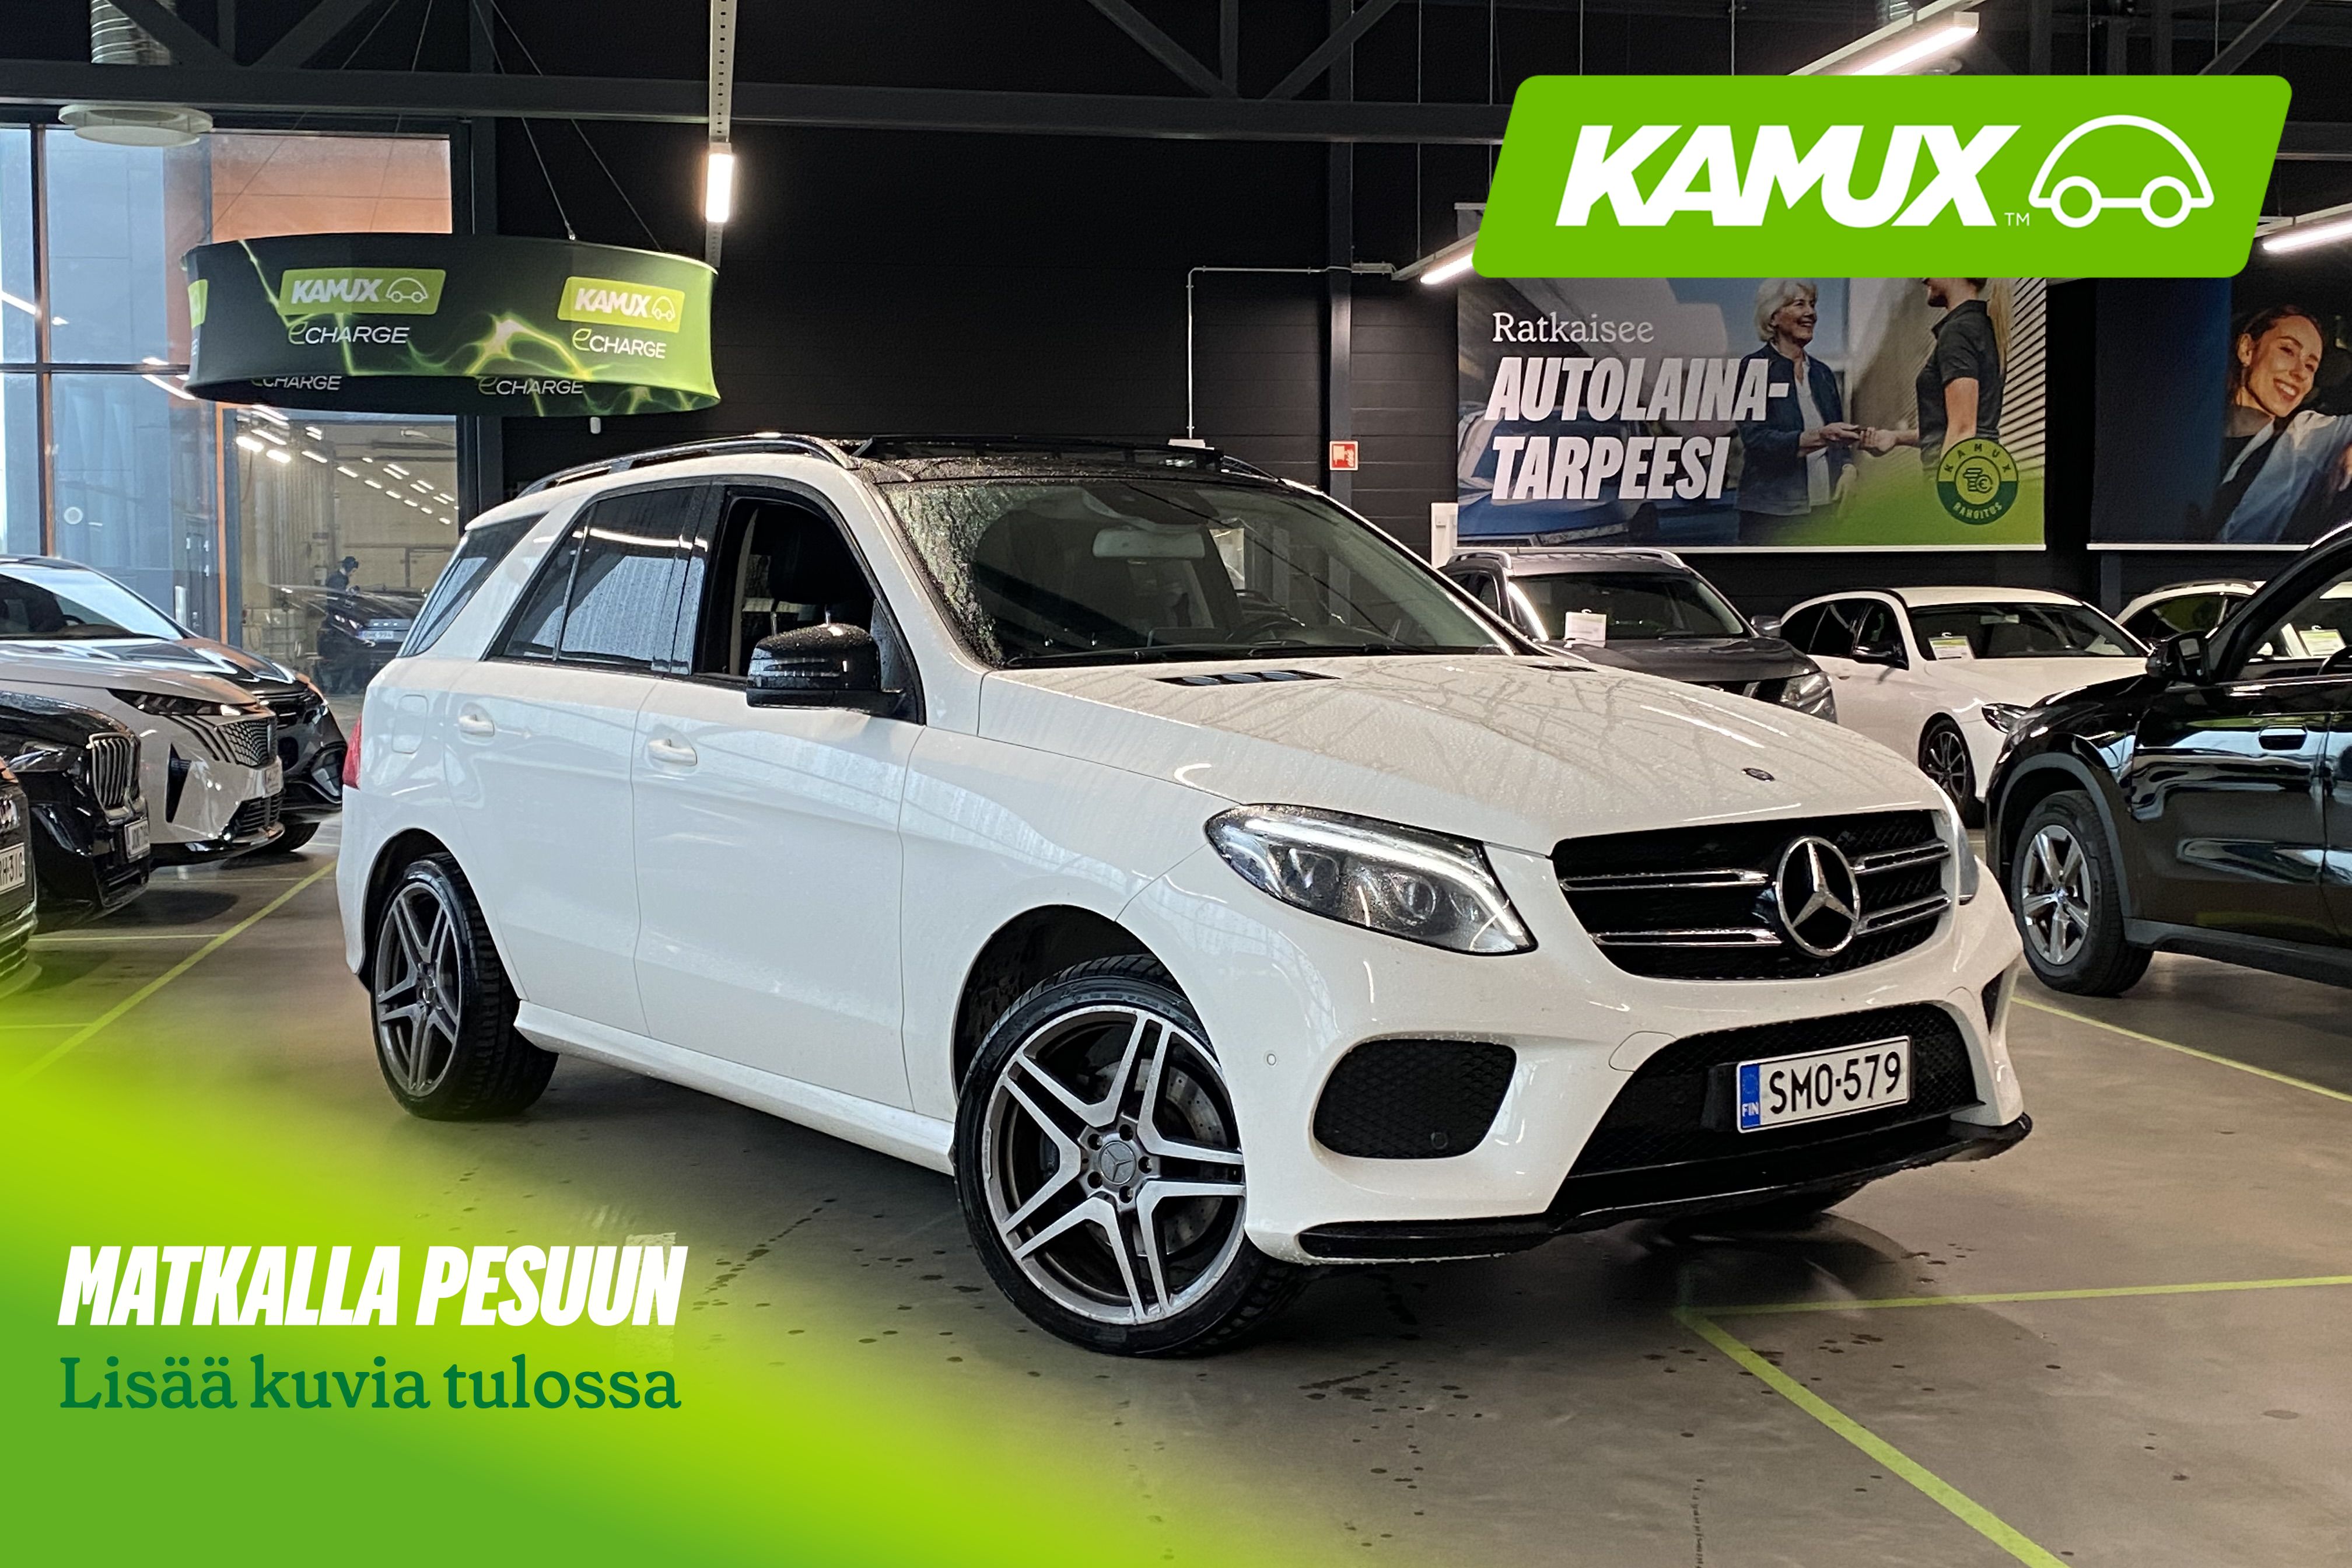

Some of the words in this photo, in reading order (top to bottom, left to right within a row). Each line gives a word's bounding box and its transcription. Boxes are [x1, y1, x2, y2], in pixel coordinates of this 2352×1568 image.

[292, 278, 383, 304] KAMUX
[574, 288, 651, 318] KAMUX
[1492, 311, 1655, 343] Ratkaisee
[1483, 356, 1790, 421] AUTOLAINA-
[1491, 436, 1731, 500] TARPEESI
[1944, 443, 2011, 473] KAMUX
[1952, 502, 2003, 519] RAHOITUS
[1769, 1051, 1901, 1114] SMO-579
[1742, 1101, 1760, 1118] FIN
